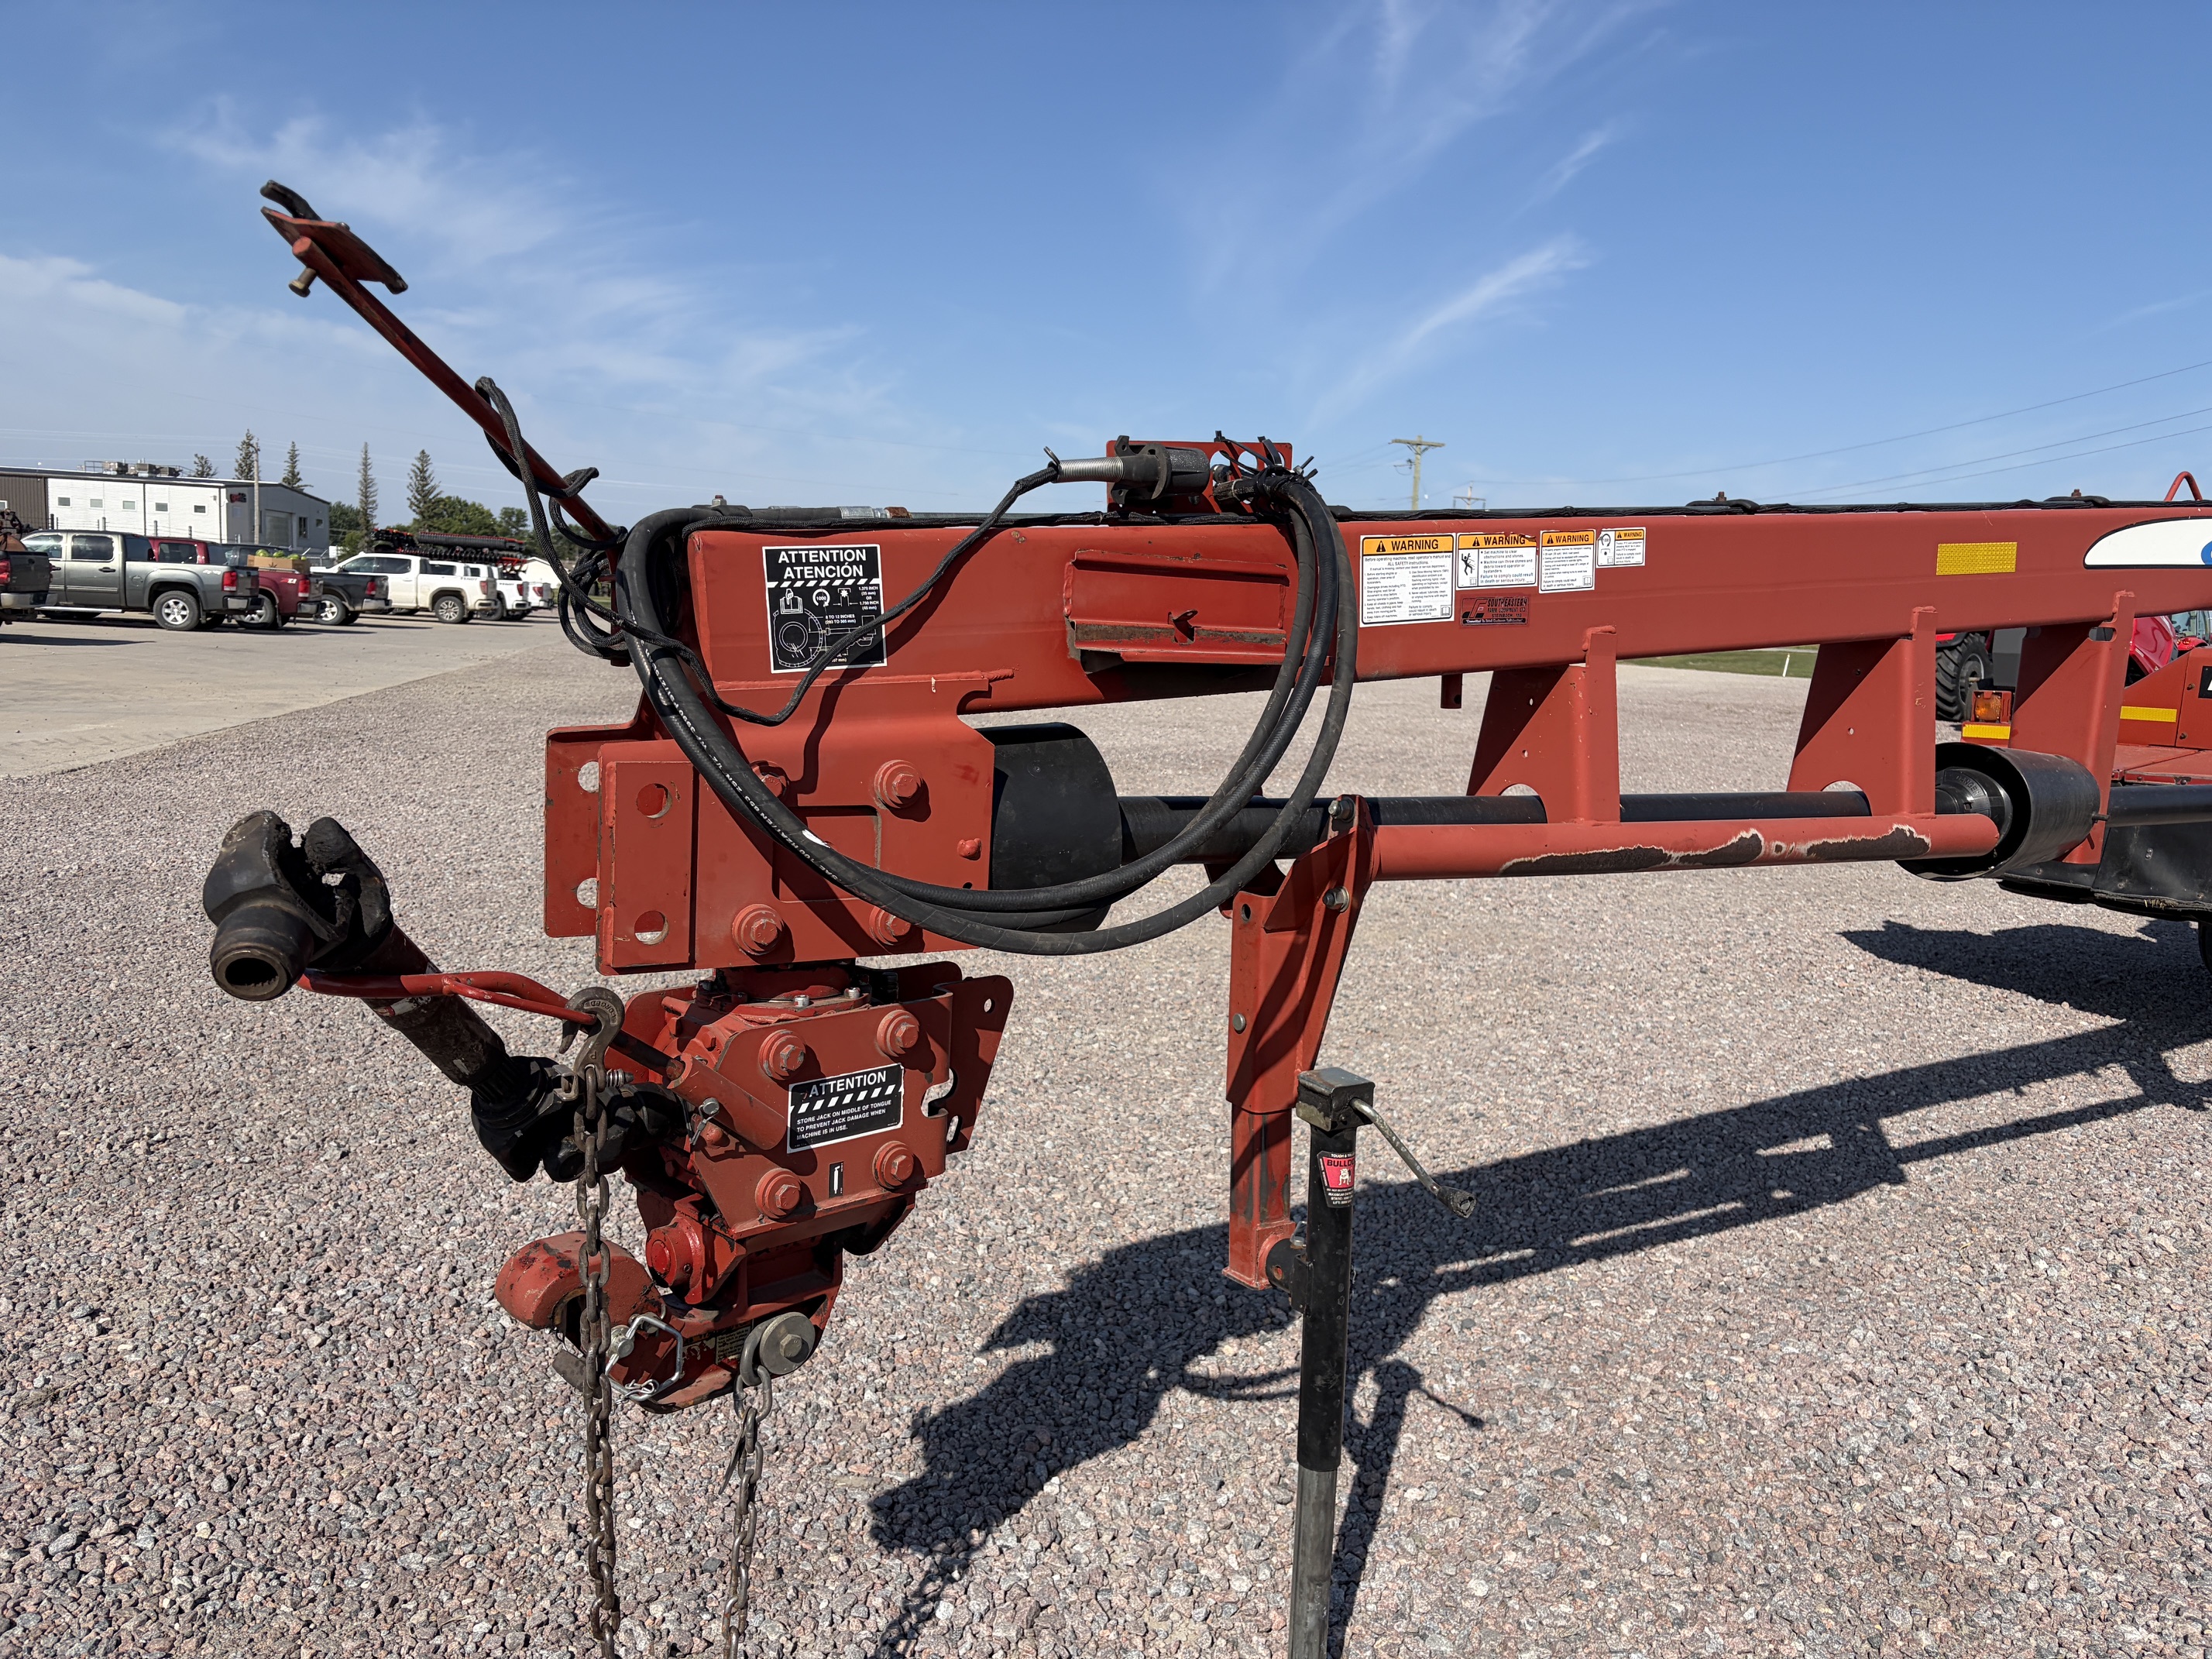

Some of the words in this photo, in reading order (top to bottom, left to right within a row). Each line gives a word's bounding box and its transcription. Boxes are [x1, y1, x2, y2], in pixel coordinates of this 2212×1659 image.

[1391, 539, 1438, 551] WARNING
[1484, 536, 1526, 545] WARNING
[1556, 534, 1589, 543] WARNING
[778, 549, 866, 564] ATTENTION
[784, 562, 863, 579] ATENCIÓN
[809, 1070, 887, 1098] ATTENTION
[797, 1117, 816, 1125] STORE
[841, 1107, 861, 1115] MIDDLE
[871, 1100, 891, 1108] TONGUE
[805, 1121, 830, 1131] PREVENT
[831, 1117, 847, 1125] JACK
[847, 1111, 869, 1121] DAMAGE
[871, 1108, 886, 1117] WHEN
[796, 1130, 822, 1141] MACHINE
